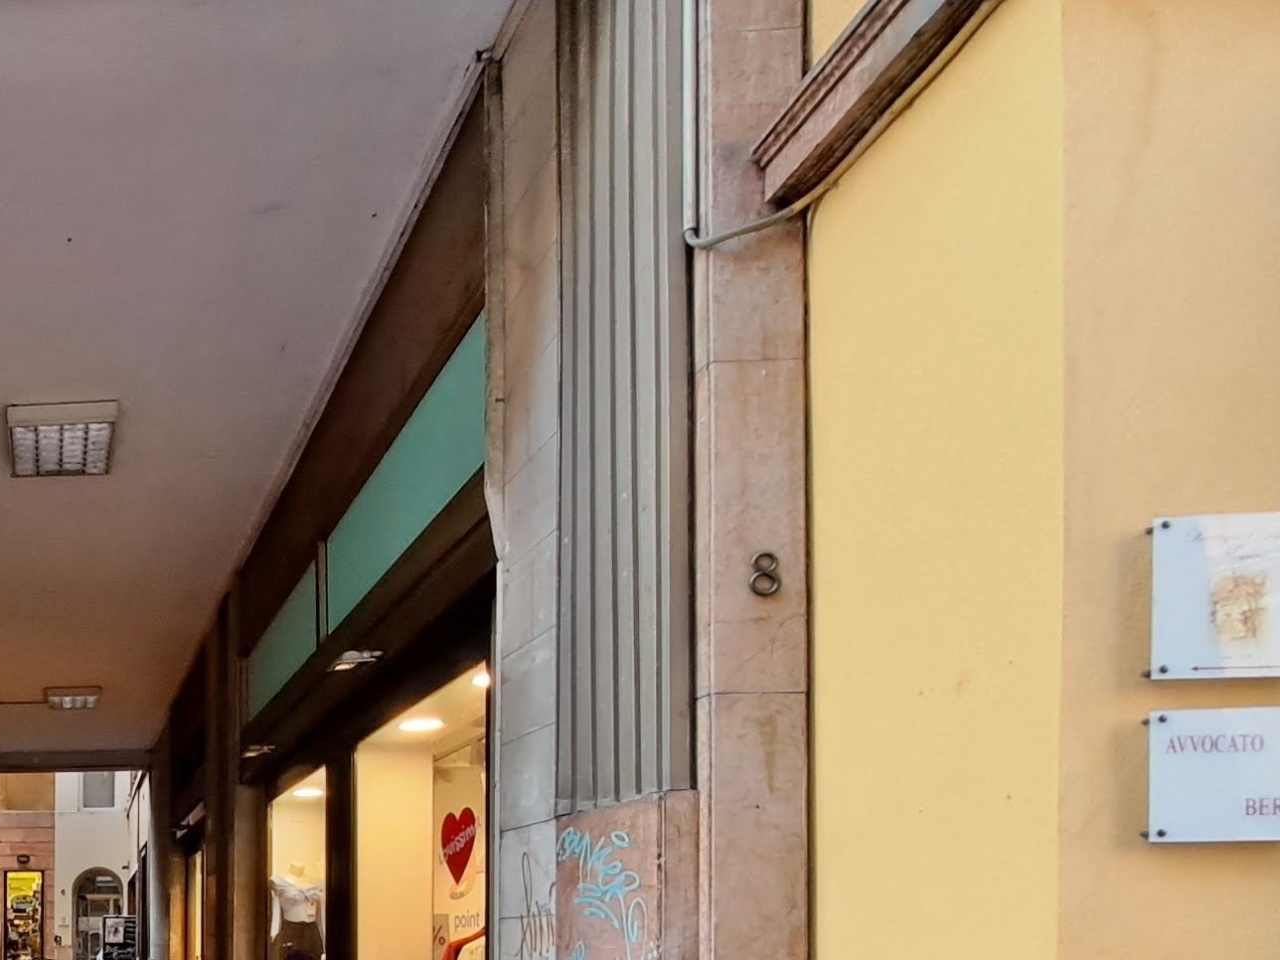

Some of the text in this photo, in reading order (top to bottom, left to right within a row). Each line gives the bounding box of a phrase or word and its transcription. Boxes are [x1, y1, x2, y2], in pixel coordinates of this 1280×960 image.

[749, 552, 782, 597] 8
[1166, 733, 1265, 755] AVVOCATO
[454, 910, 480, 932] point
